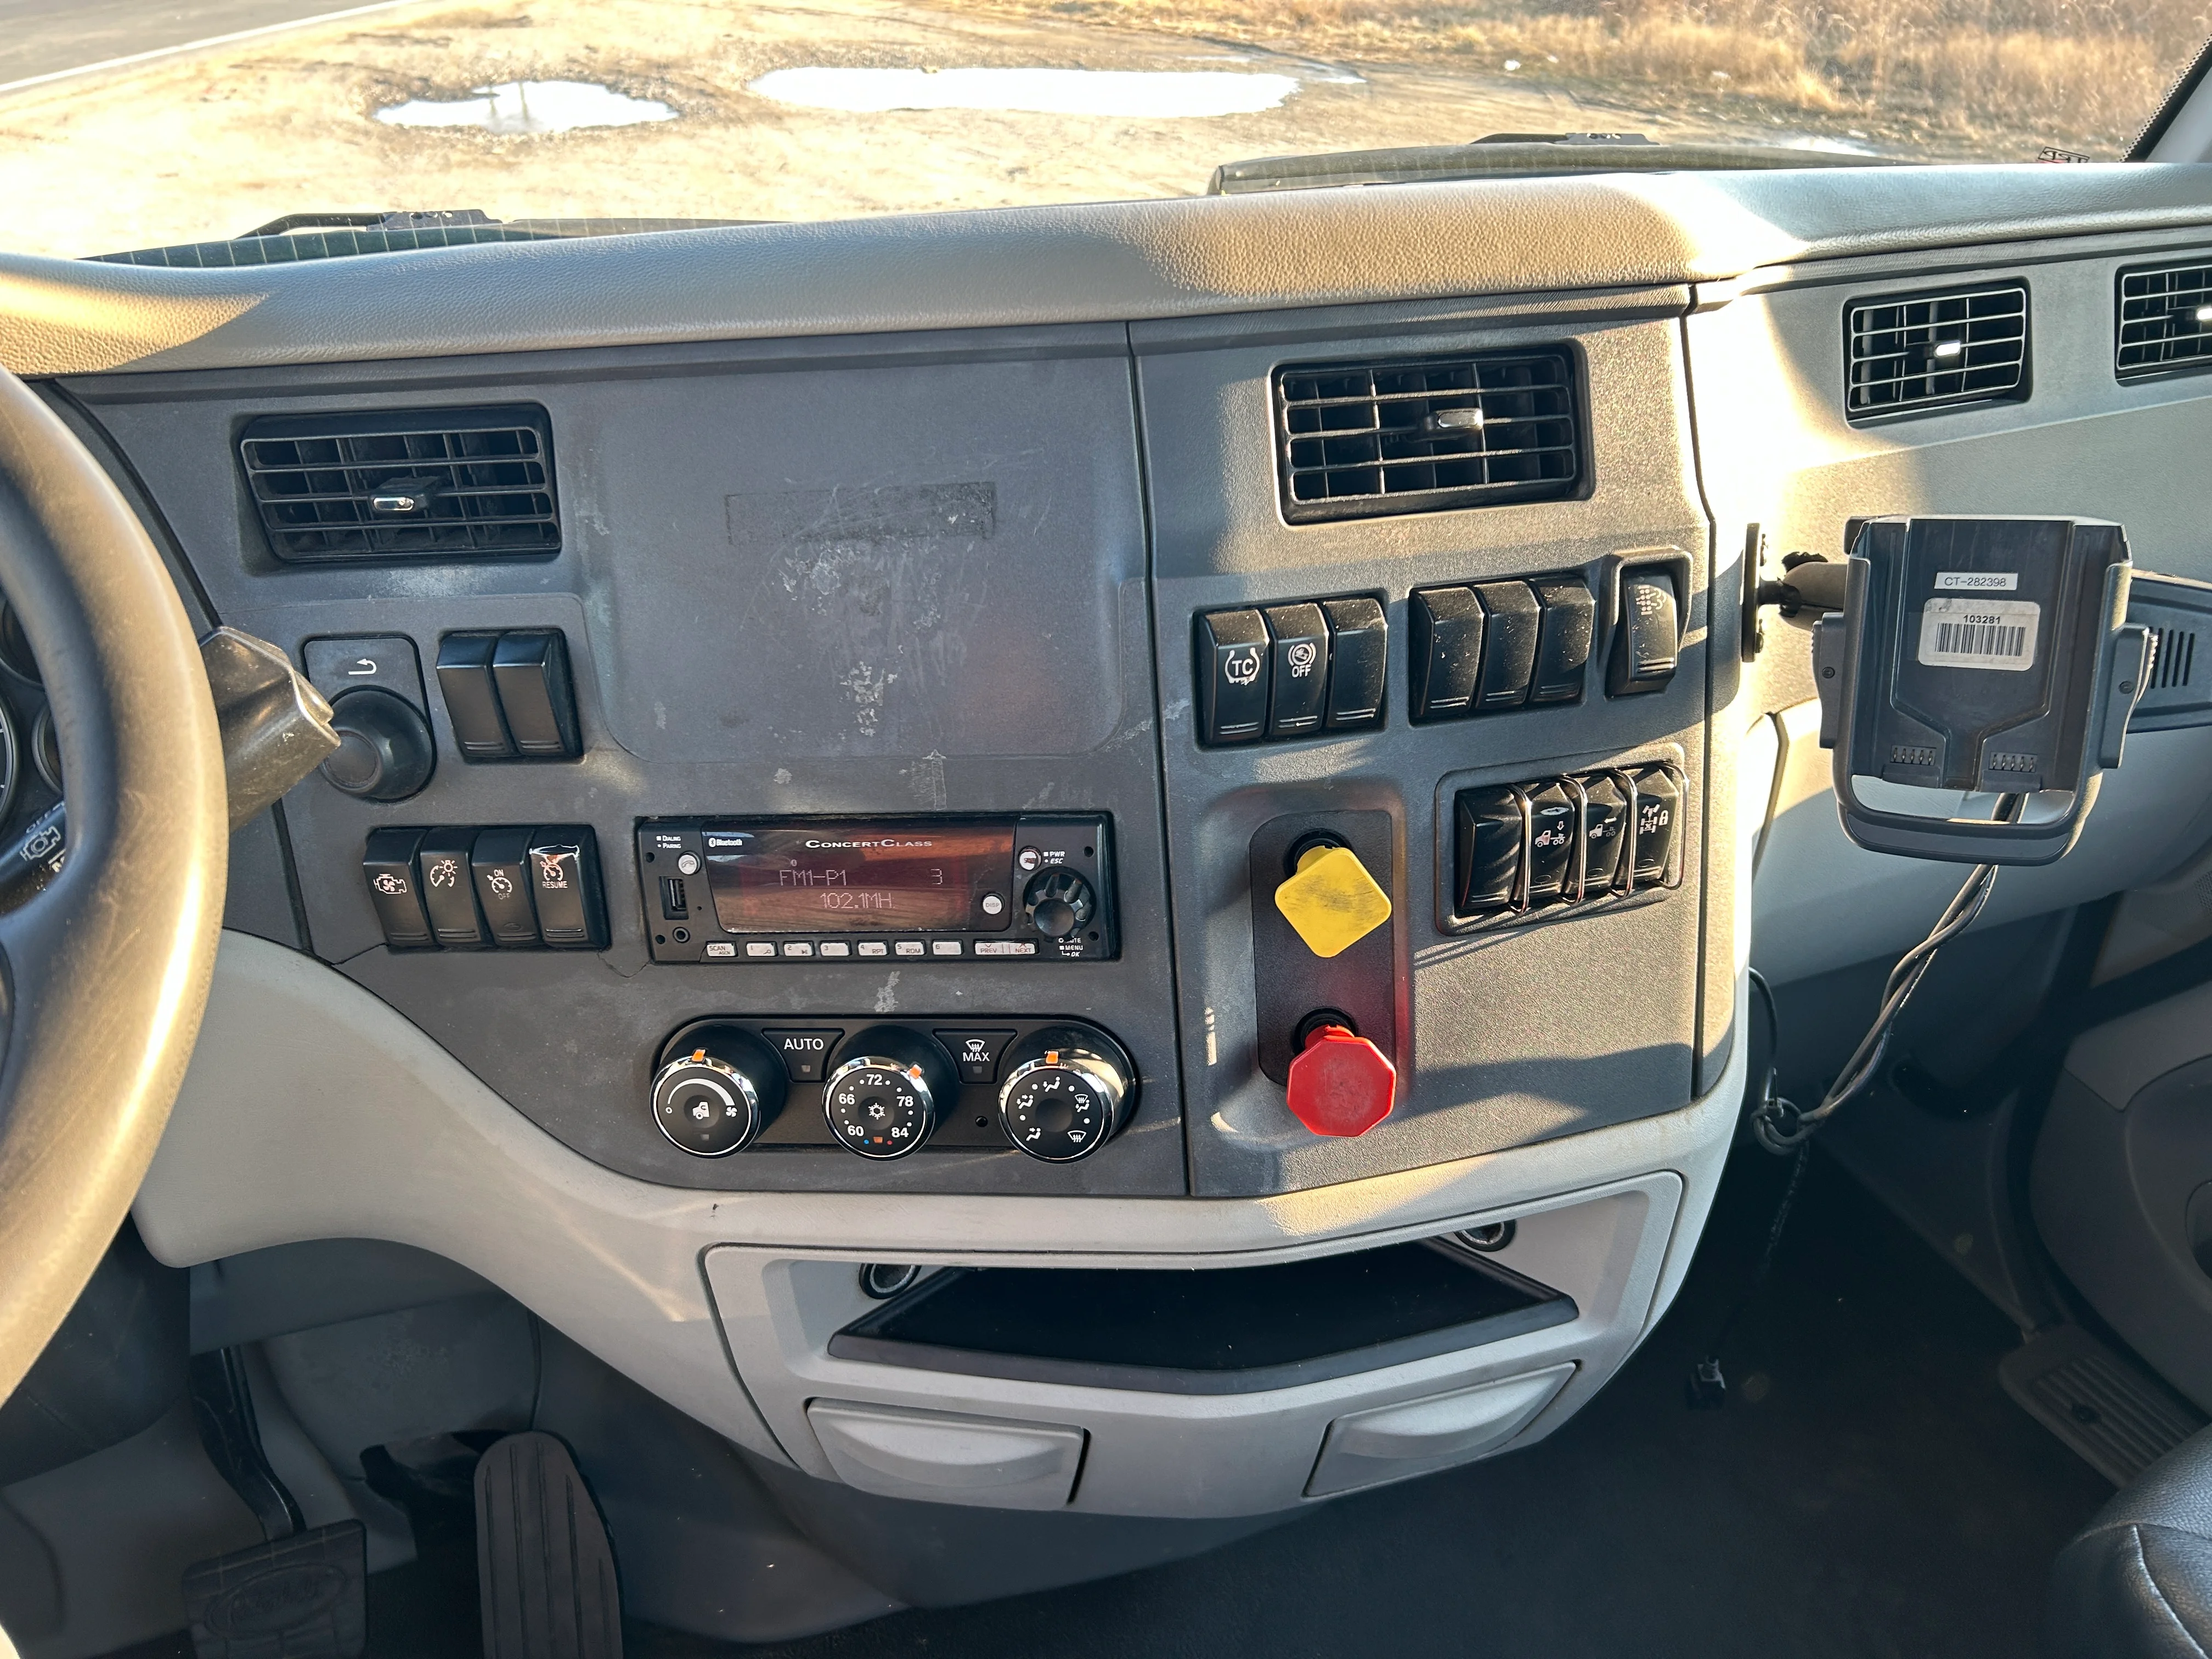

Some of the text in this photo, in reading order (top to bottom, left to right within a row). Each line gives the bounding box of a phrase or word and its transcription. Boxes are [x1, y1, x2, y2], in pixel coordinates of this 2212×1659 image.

[1944, 577, 2006, 586] CT-282398
[1963, 614, 2001, 624] 103281
[1232, 658, 1253, 676] TC
[1292, 664, 1311, 678] OFF
[779, 868, 943, 886] FM1-P1 3
[542, 881, 568, 889] RESUME
[784, 1038, 824, 1050] AUTO
[963, 1052, 990, 1062] MAX
[866, 1074, 883, 1085] 72
[838, 1093, 855, 1104] 66
[896, 1096, 913, 1107] 78
[847, 1125, 864, 1136] 60
[891, 1127, 909, 1138] 84
